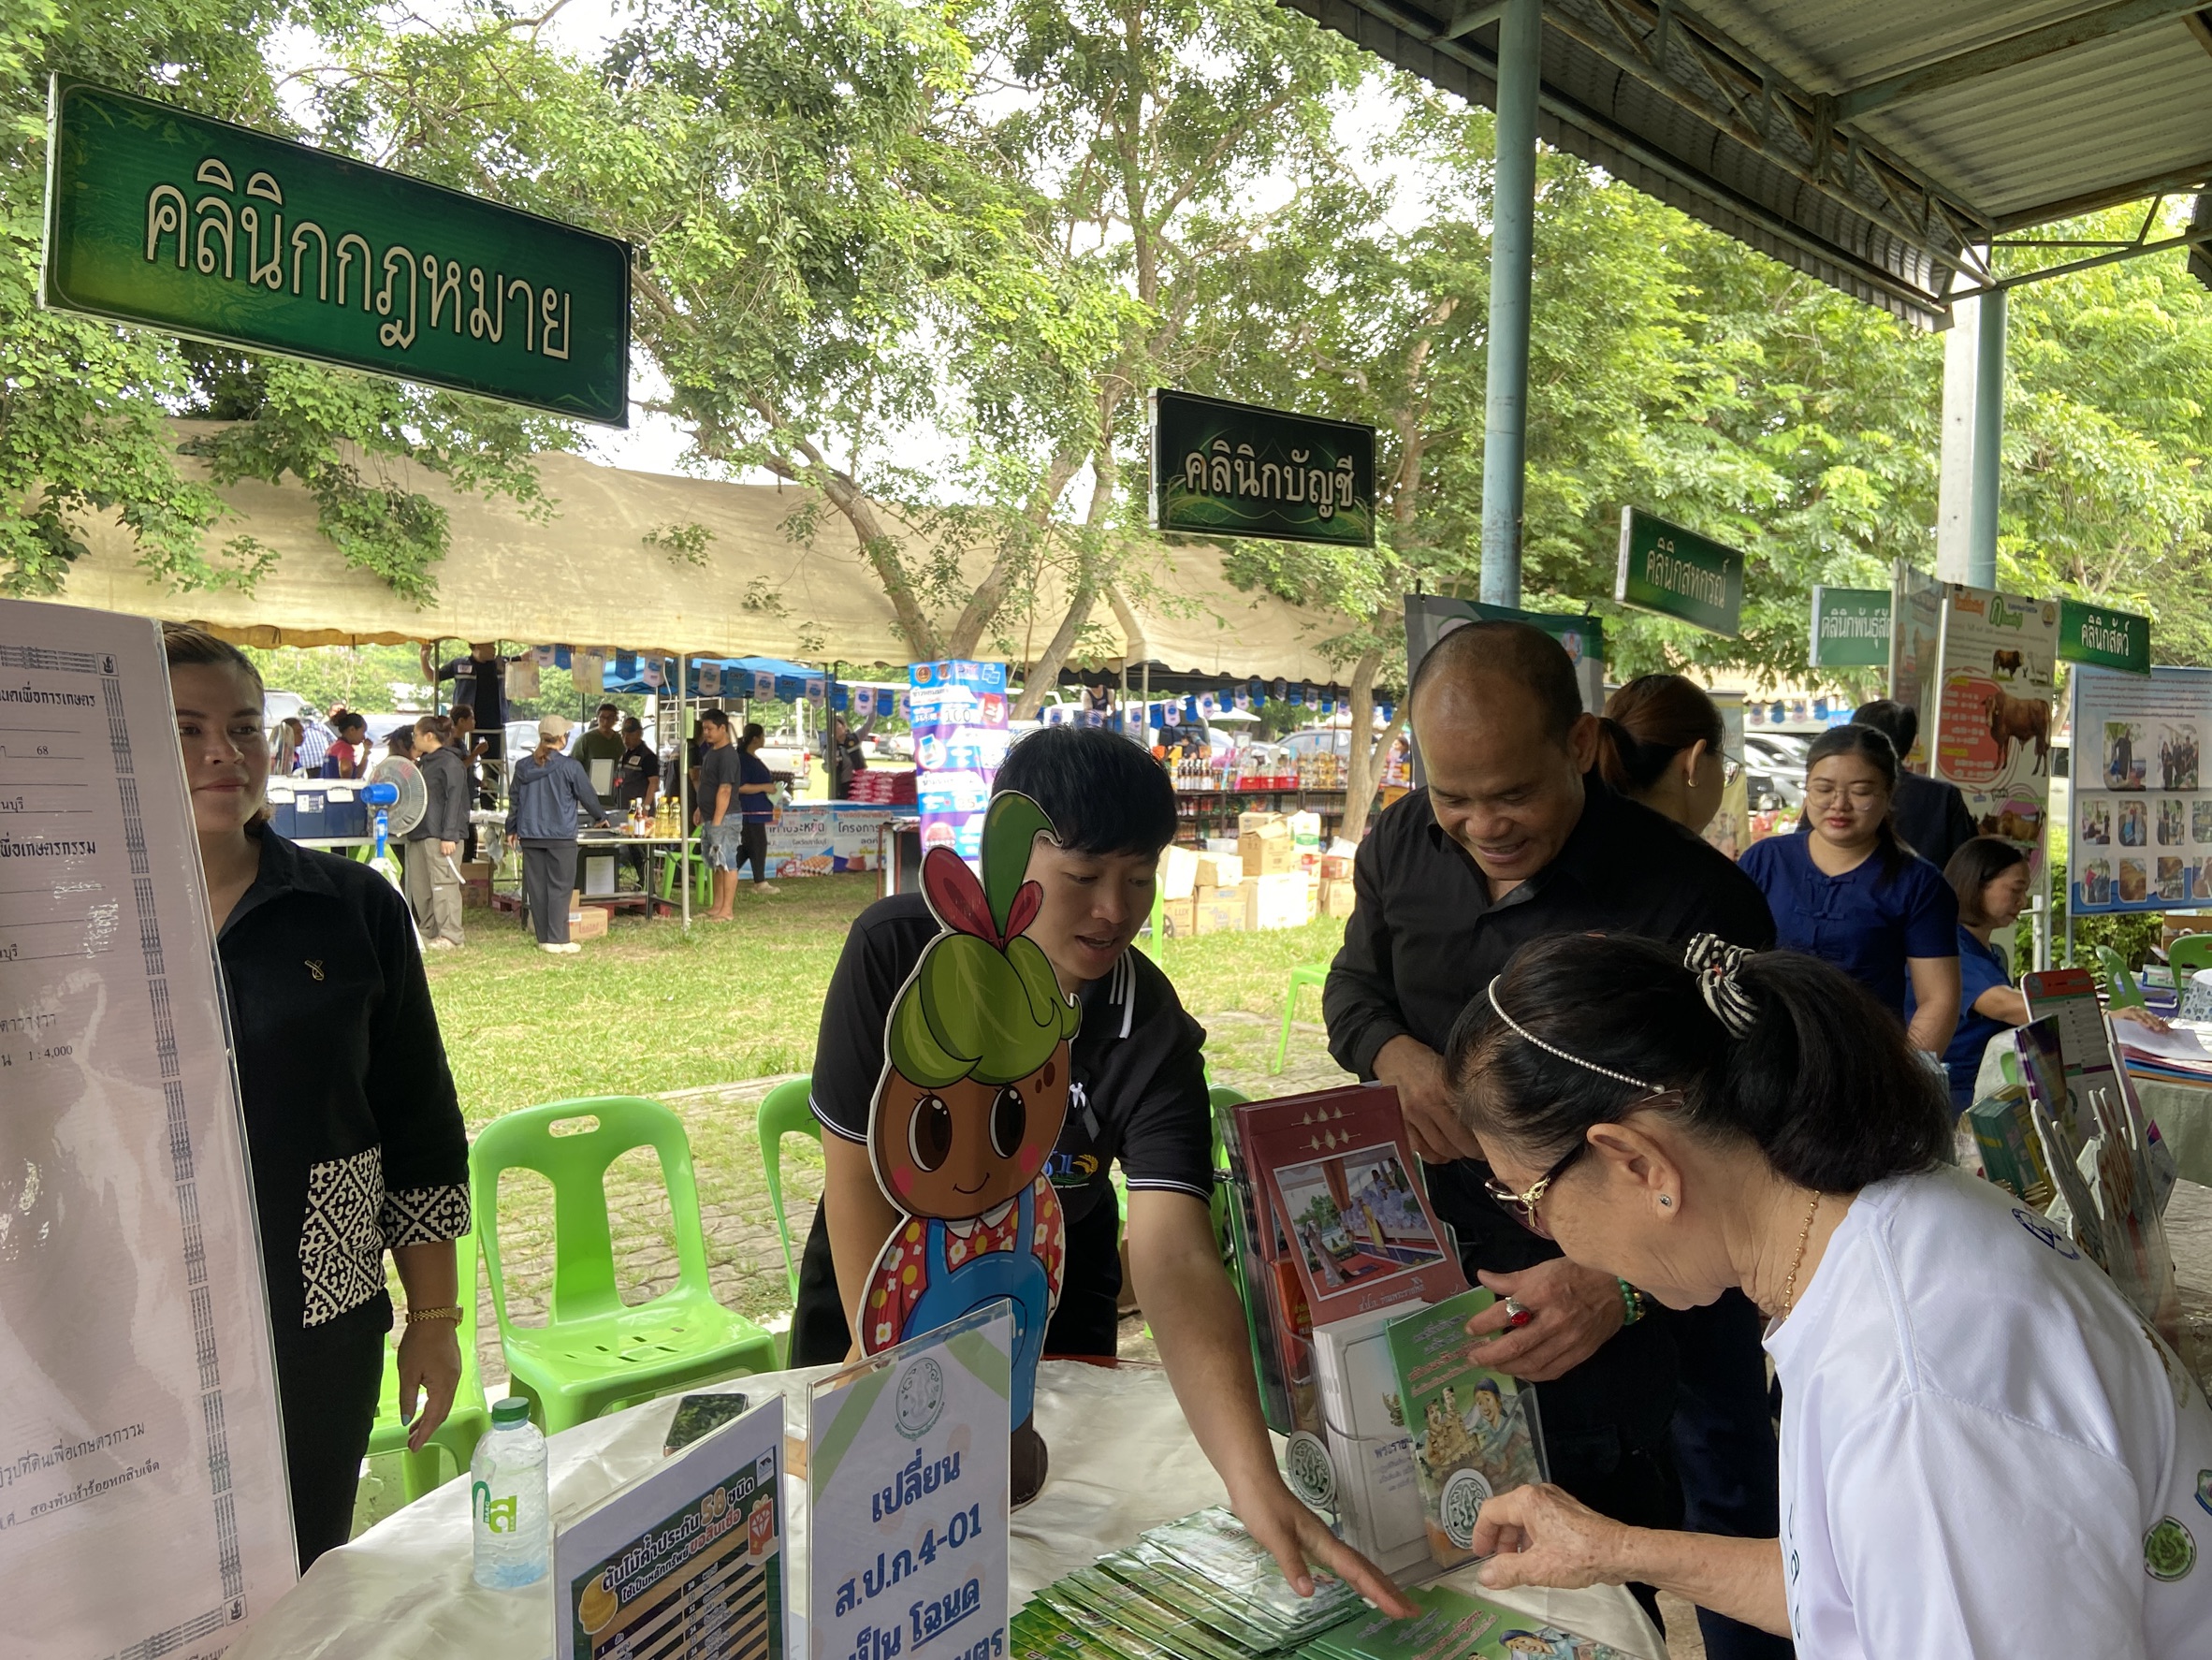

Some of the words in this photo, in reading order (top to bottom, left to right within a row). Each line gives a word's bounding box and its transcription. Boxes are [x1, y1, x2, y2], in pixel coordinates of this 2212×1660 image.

[144, 157, 571, 361] คลินิกกฎหมาย
[1185, 439, 1355, 518] คลินิกบัญชี
[1646, 537, 1730, 609] คลินิกสหกรณ์
[2081, 614, 2131, 657] คลินิกสัตว์
[0, 681, 95, 706] นดเพื่อการเกษตร
[36, 746, 49, 755] 68
[0, 831, 95, 858] พื่อเกษตรกรรม
[44, 1045, 73, 1059] 4,000
[872, 1448, 960, 1523] เปลี่ยน
[602, 1515, 700, 1592] ต้นไม้ค้ำประกัน
[701, 1487, 726, 1526] 58
[727, 1477, 754, 1506] ชนิด
[836, 1503, 982, 1617] ส.ป.ก.4-01
[847, 1625, 901, 1660] ป็น
[909, 1578, 980, 1642] โฉนด
